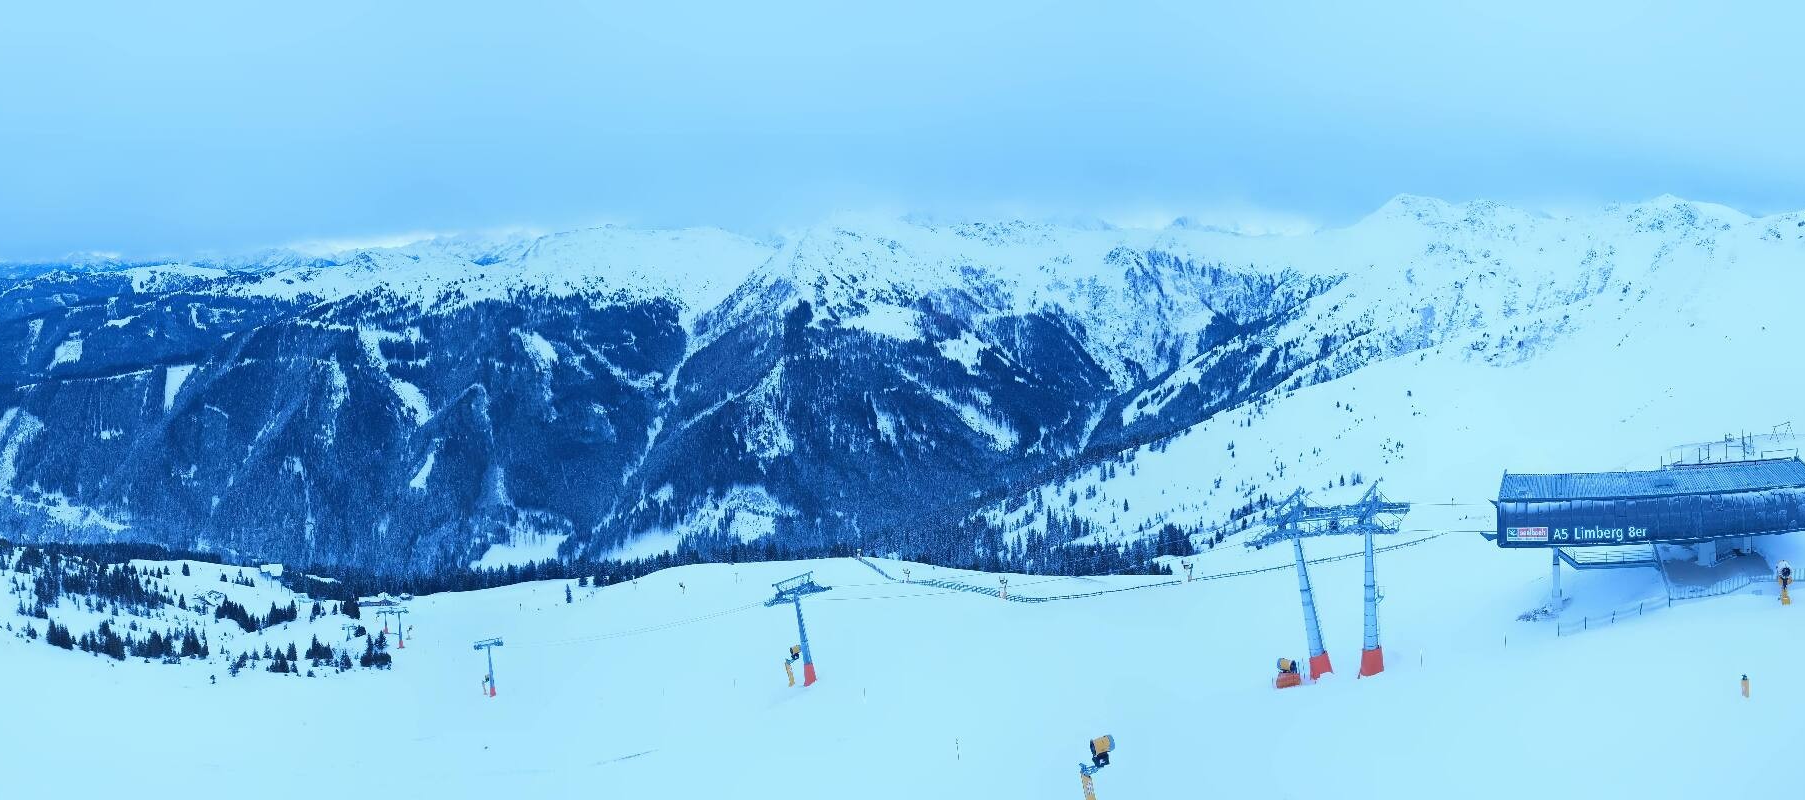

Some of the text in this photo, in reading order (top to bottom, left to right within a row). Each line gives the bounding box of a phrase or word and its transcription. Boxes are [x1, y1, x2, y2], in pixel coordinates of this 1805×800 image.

[1553, 525, 1647, 542] A5 Limberg 8er
